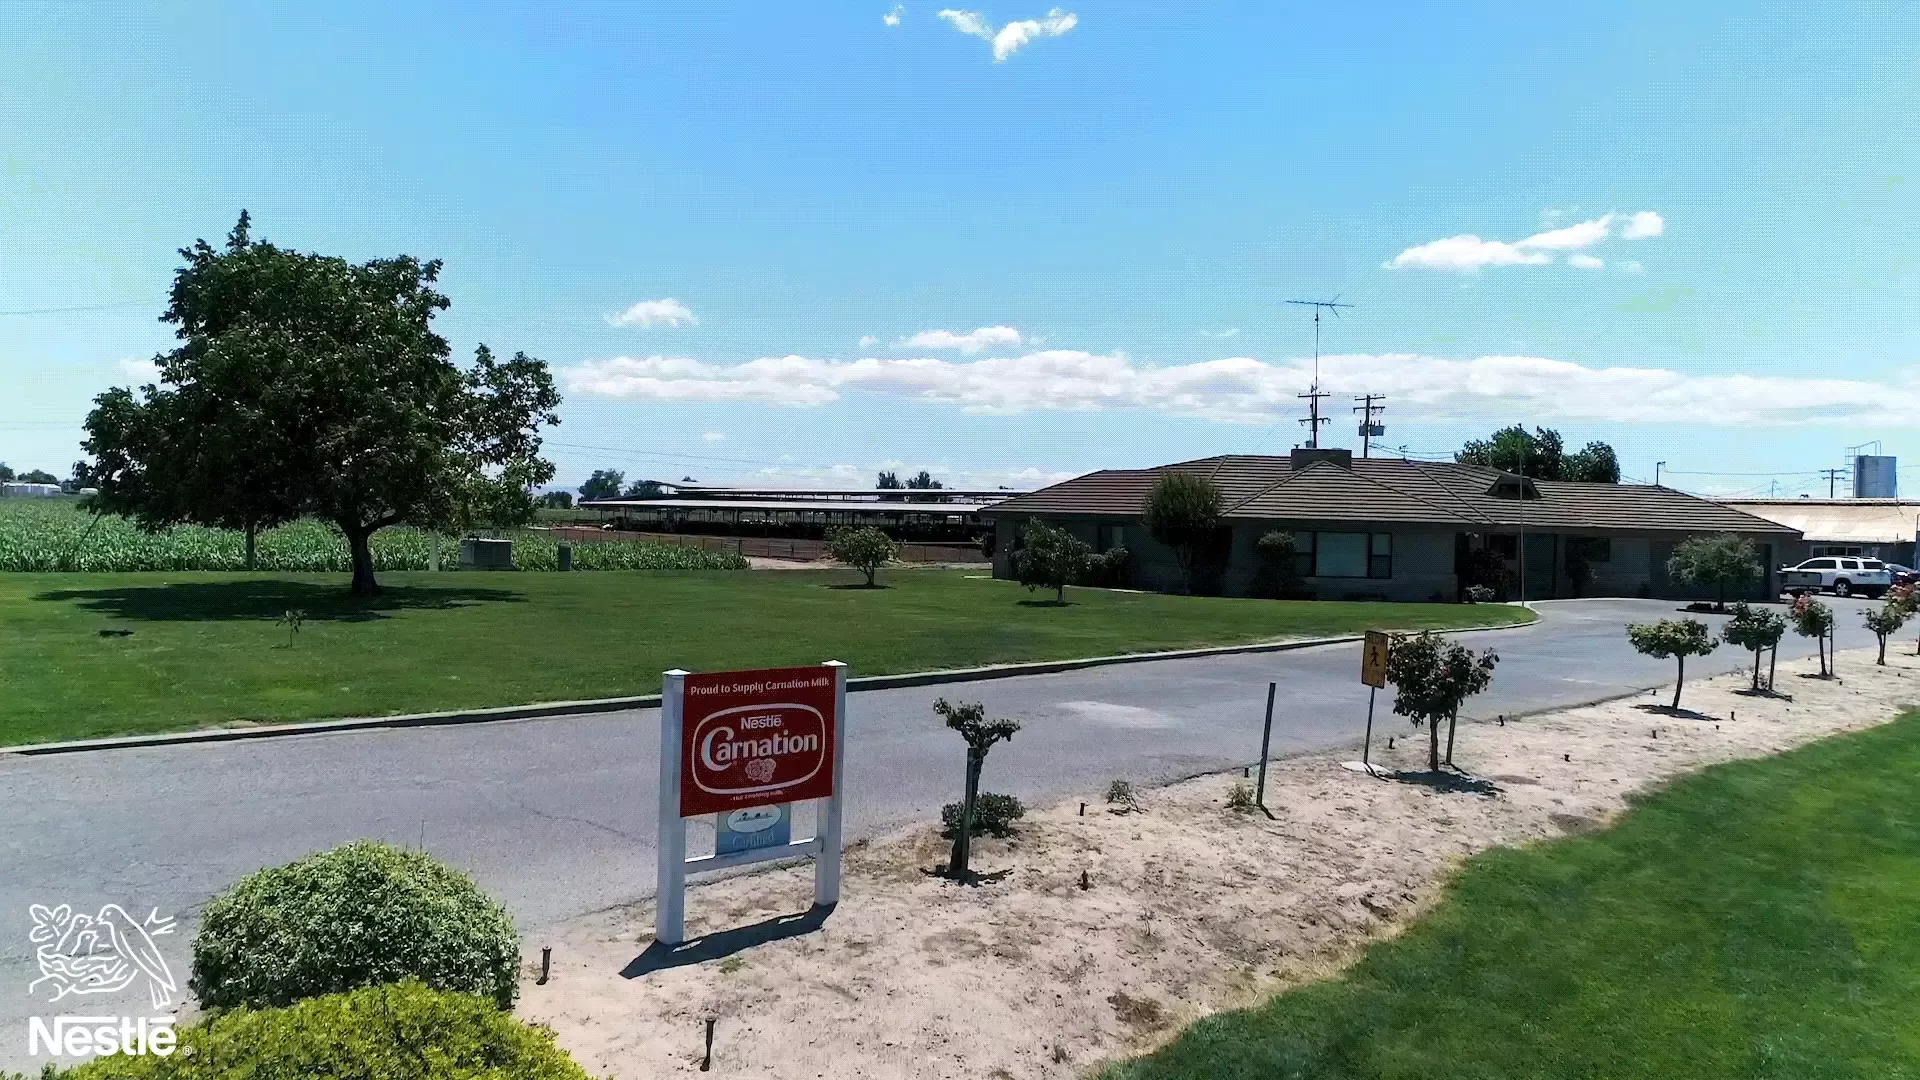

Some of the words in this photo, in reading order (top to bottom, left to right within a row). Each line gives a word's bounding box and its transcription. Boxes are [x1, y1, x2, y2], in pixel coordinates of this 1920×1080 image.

[690, 684, 719, 695] Proud
[721, 684, 731, 694] to
[732, 682, 764, 694] Supply
[765, 679, 810, 690] Carnation
[811, 677, 830, 687] Milk
[700, 726, 818, 772] Carnation
